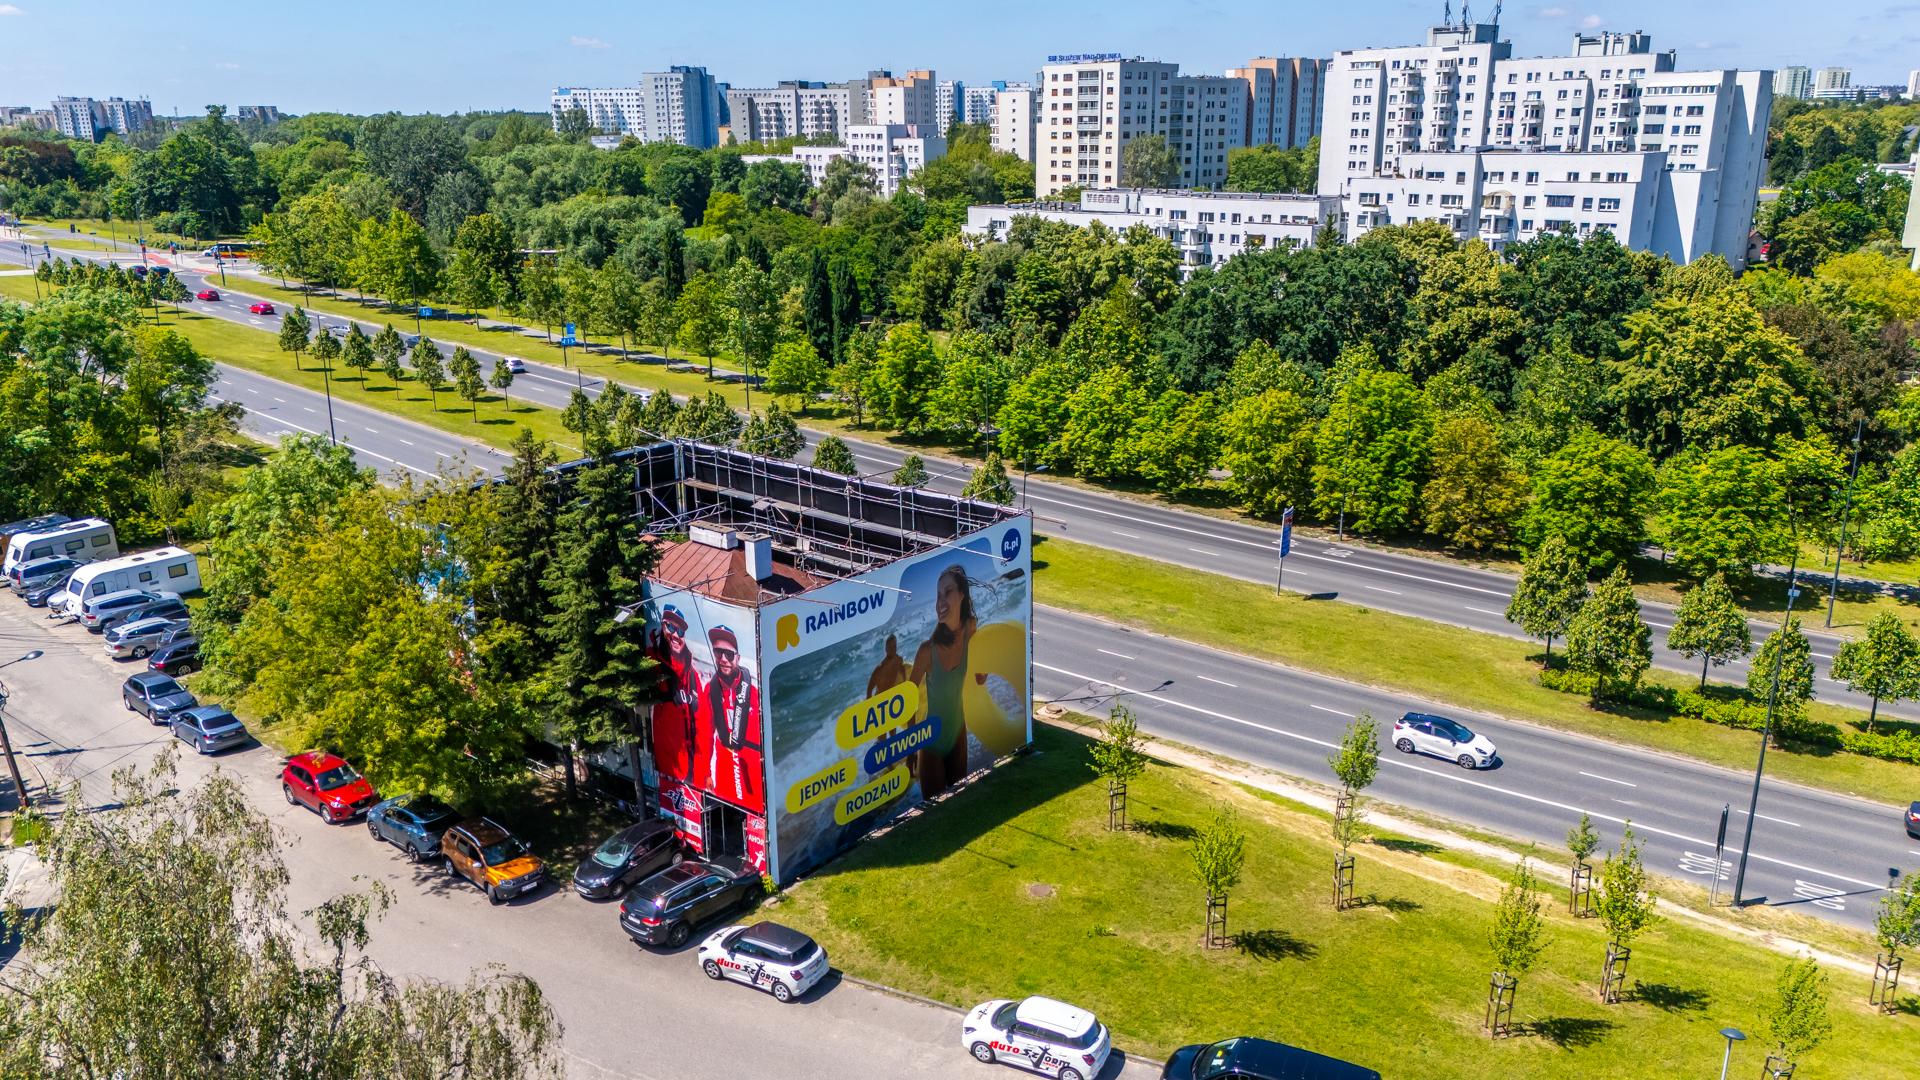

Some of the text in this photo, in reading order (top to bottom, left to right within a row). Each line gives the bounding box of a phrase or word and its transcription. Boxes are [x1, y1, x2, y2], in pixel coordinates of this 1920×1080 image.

[1004, 536, 1019, 552] R.pl
[805, 590, 885, 634] RAINBOW
[852, 694, 905, 738] LATO
[874, 724, 932, 765] W TWOIM
[799, 767, 846, 806] JEDYNE
[845, 775, 900, 815] RODZAJU
